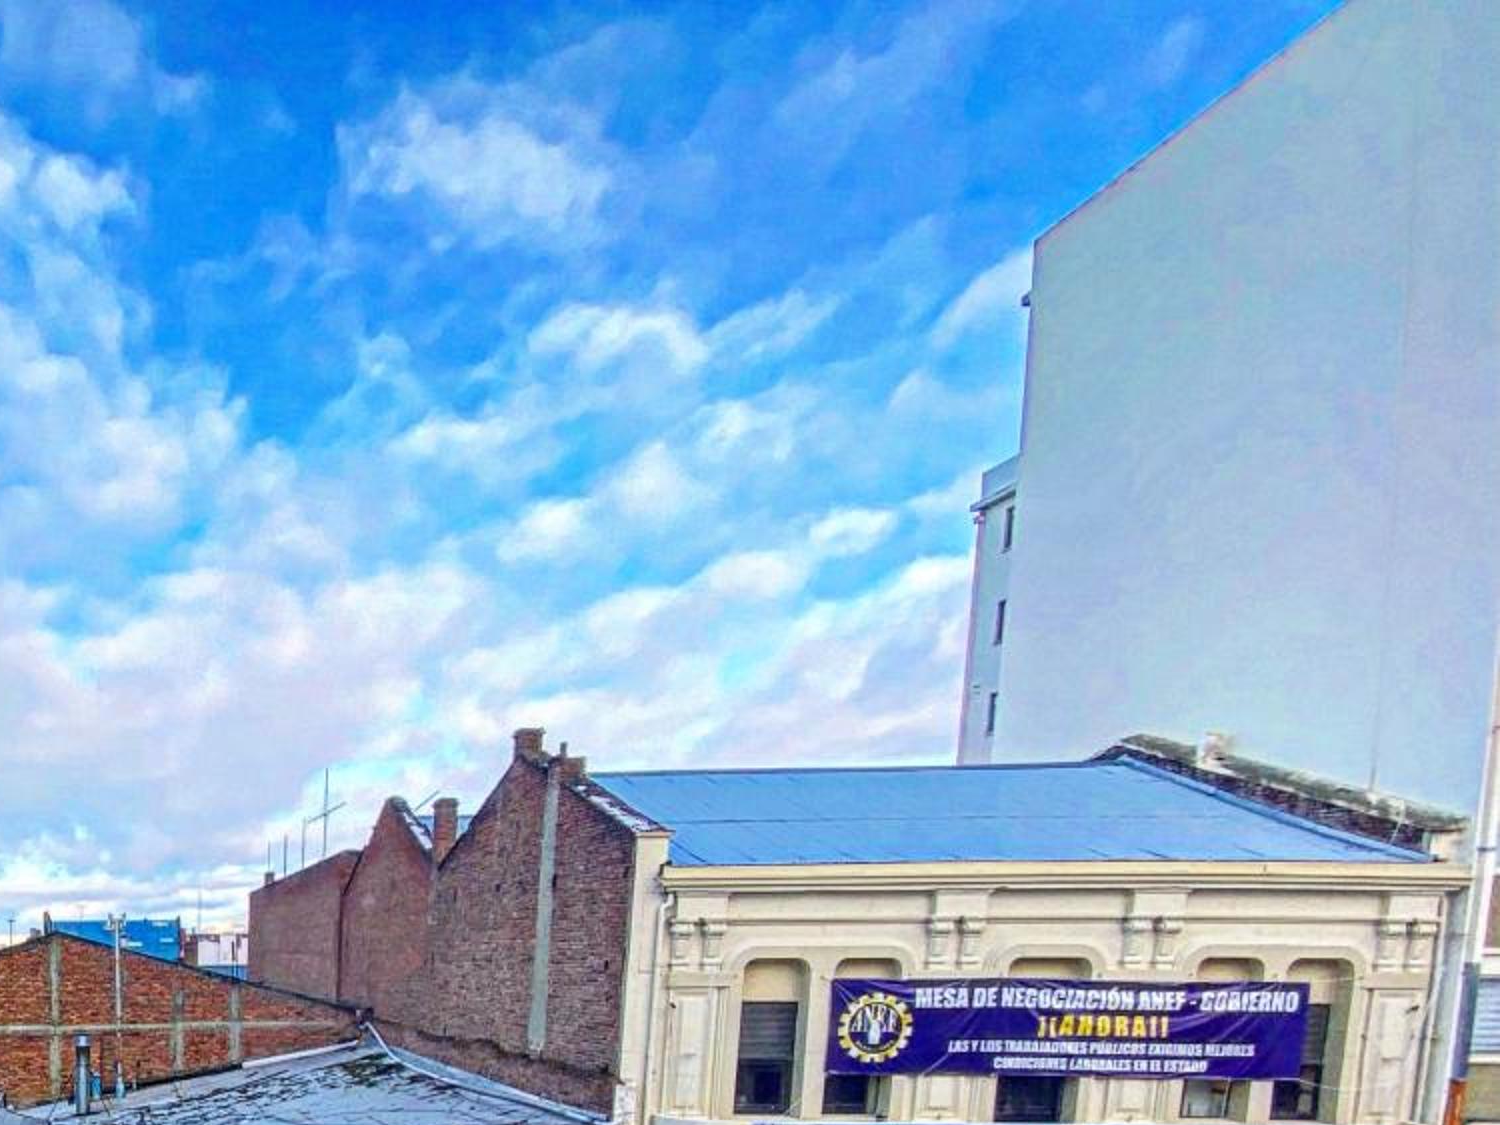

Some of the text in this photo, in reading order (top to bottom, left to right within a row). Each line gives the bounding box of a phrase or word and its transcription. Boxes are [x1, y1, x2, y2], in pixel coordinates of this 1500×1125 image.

[915, 987, 971, 1009] MESA
[972, 987, 998, 1009] DE
[1001, 986, 1134, 1011] NEGOCIACIÓN
[1138, 989, 1186, 1011] ANEF
[1200, 990, 1299, 1013] GOBIERNO
